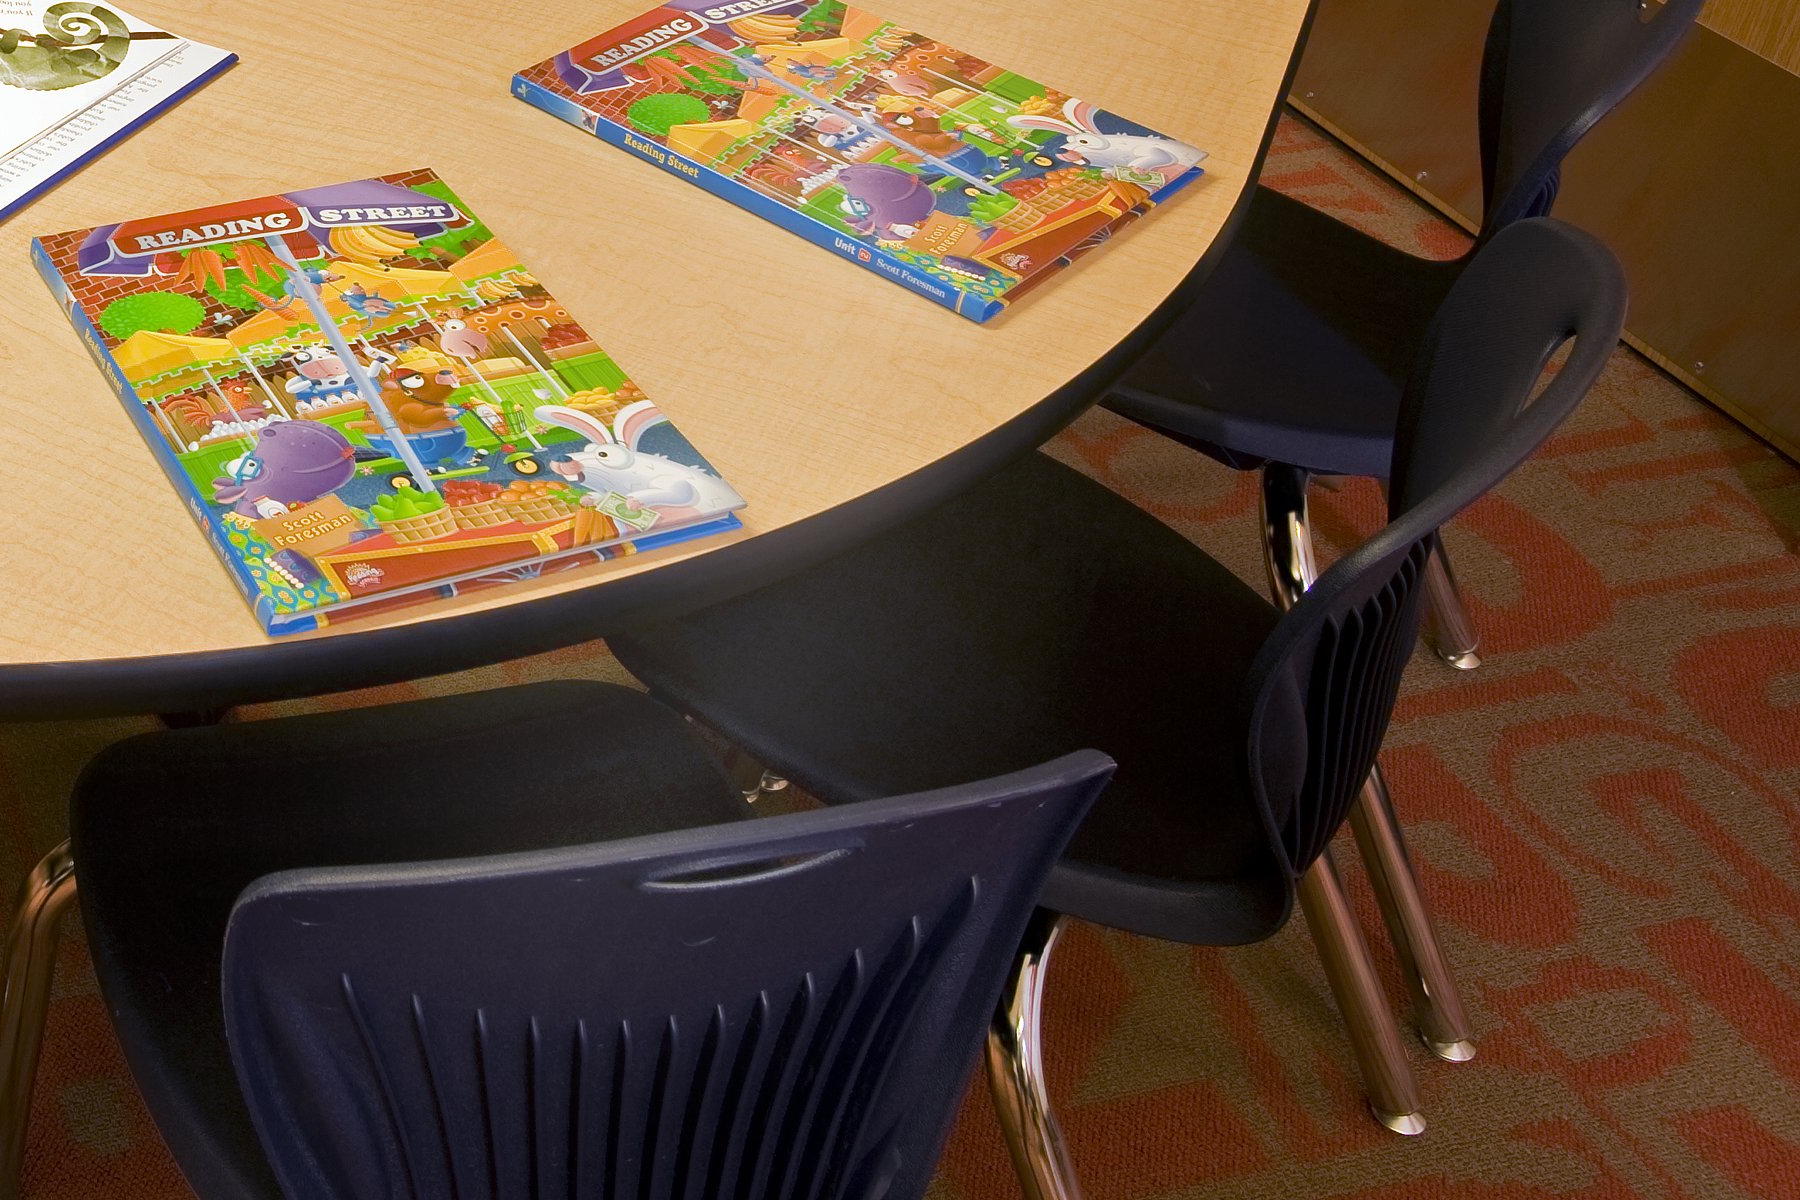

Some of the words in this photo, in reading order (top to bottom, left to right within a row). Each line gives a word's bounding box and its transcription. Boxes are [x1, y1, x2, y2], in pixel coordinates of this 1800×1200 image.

[591, 18, 693, 67] READING
[623, 133, 665, 163] Reading
[667, 156, 700, 178] Street
[135, 212, 292, 251] READING
[319, 204, 447, 223] STREET
[924, 225, 948, 243] Scott
[929, 223, 968, 255] Foresman
[834, 237, 856, 255] Unit
[876, 258, 900, 275] Scott
[901, 271, 946, 298] Foresman
[84, 328, 108, 372] Reading
[105, 361, 123, 395] Street
[190, 497, 203, 521] Unit
[282, 510, 325, 531] Scott
[274, 513, 352, 548] Foresman
